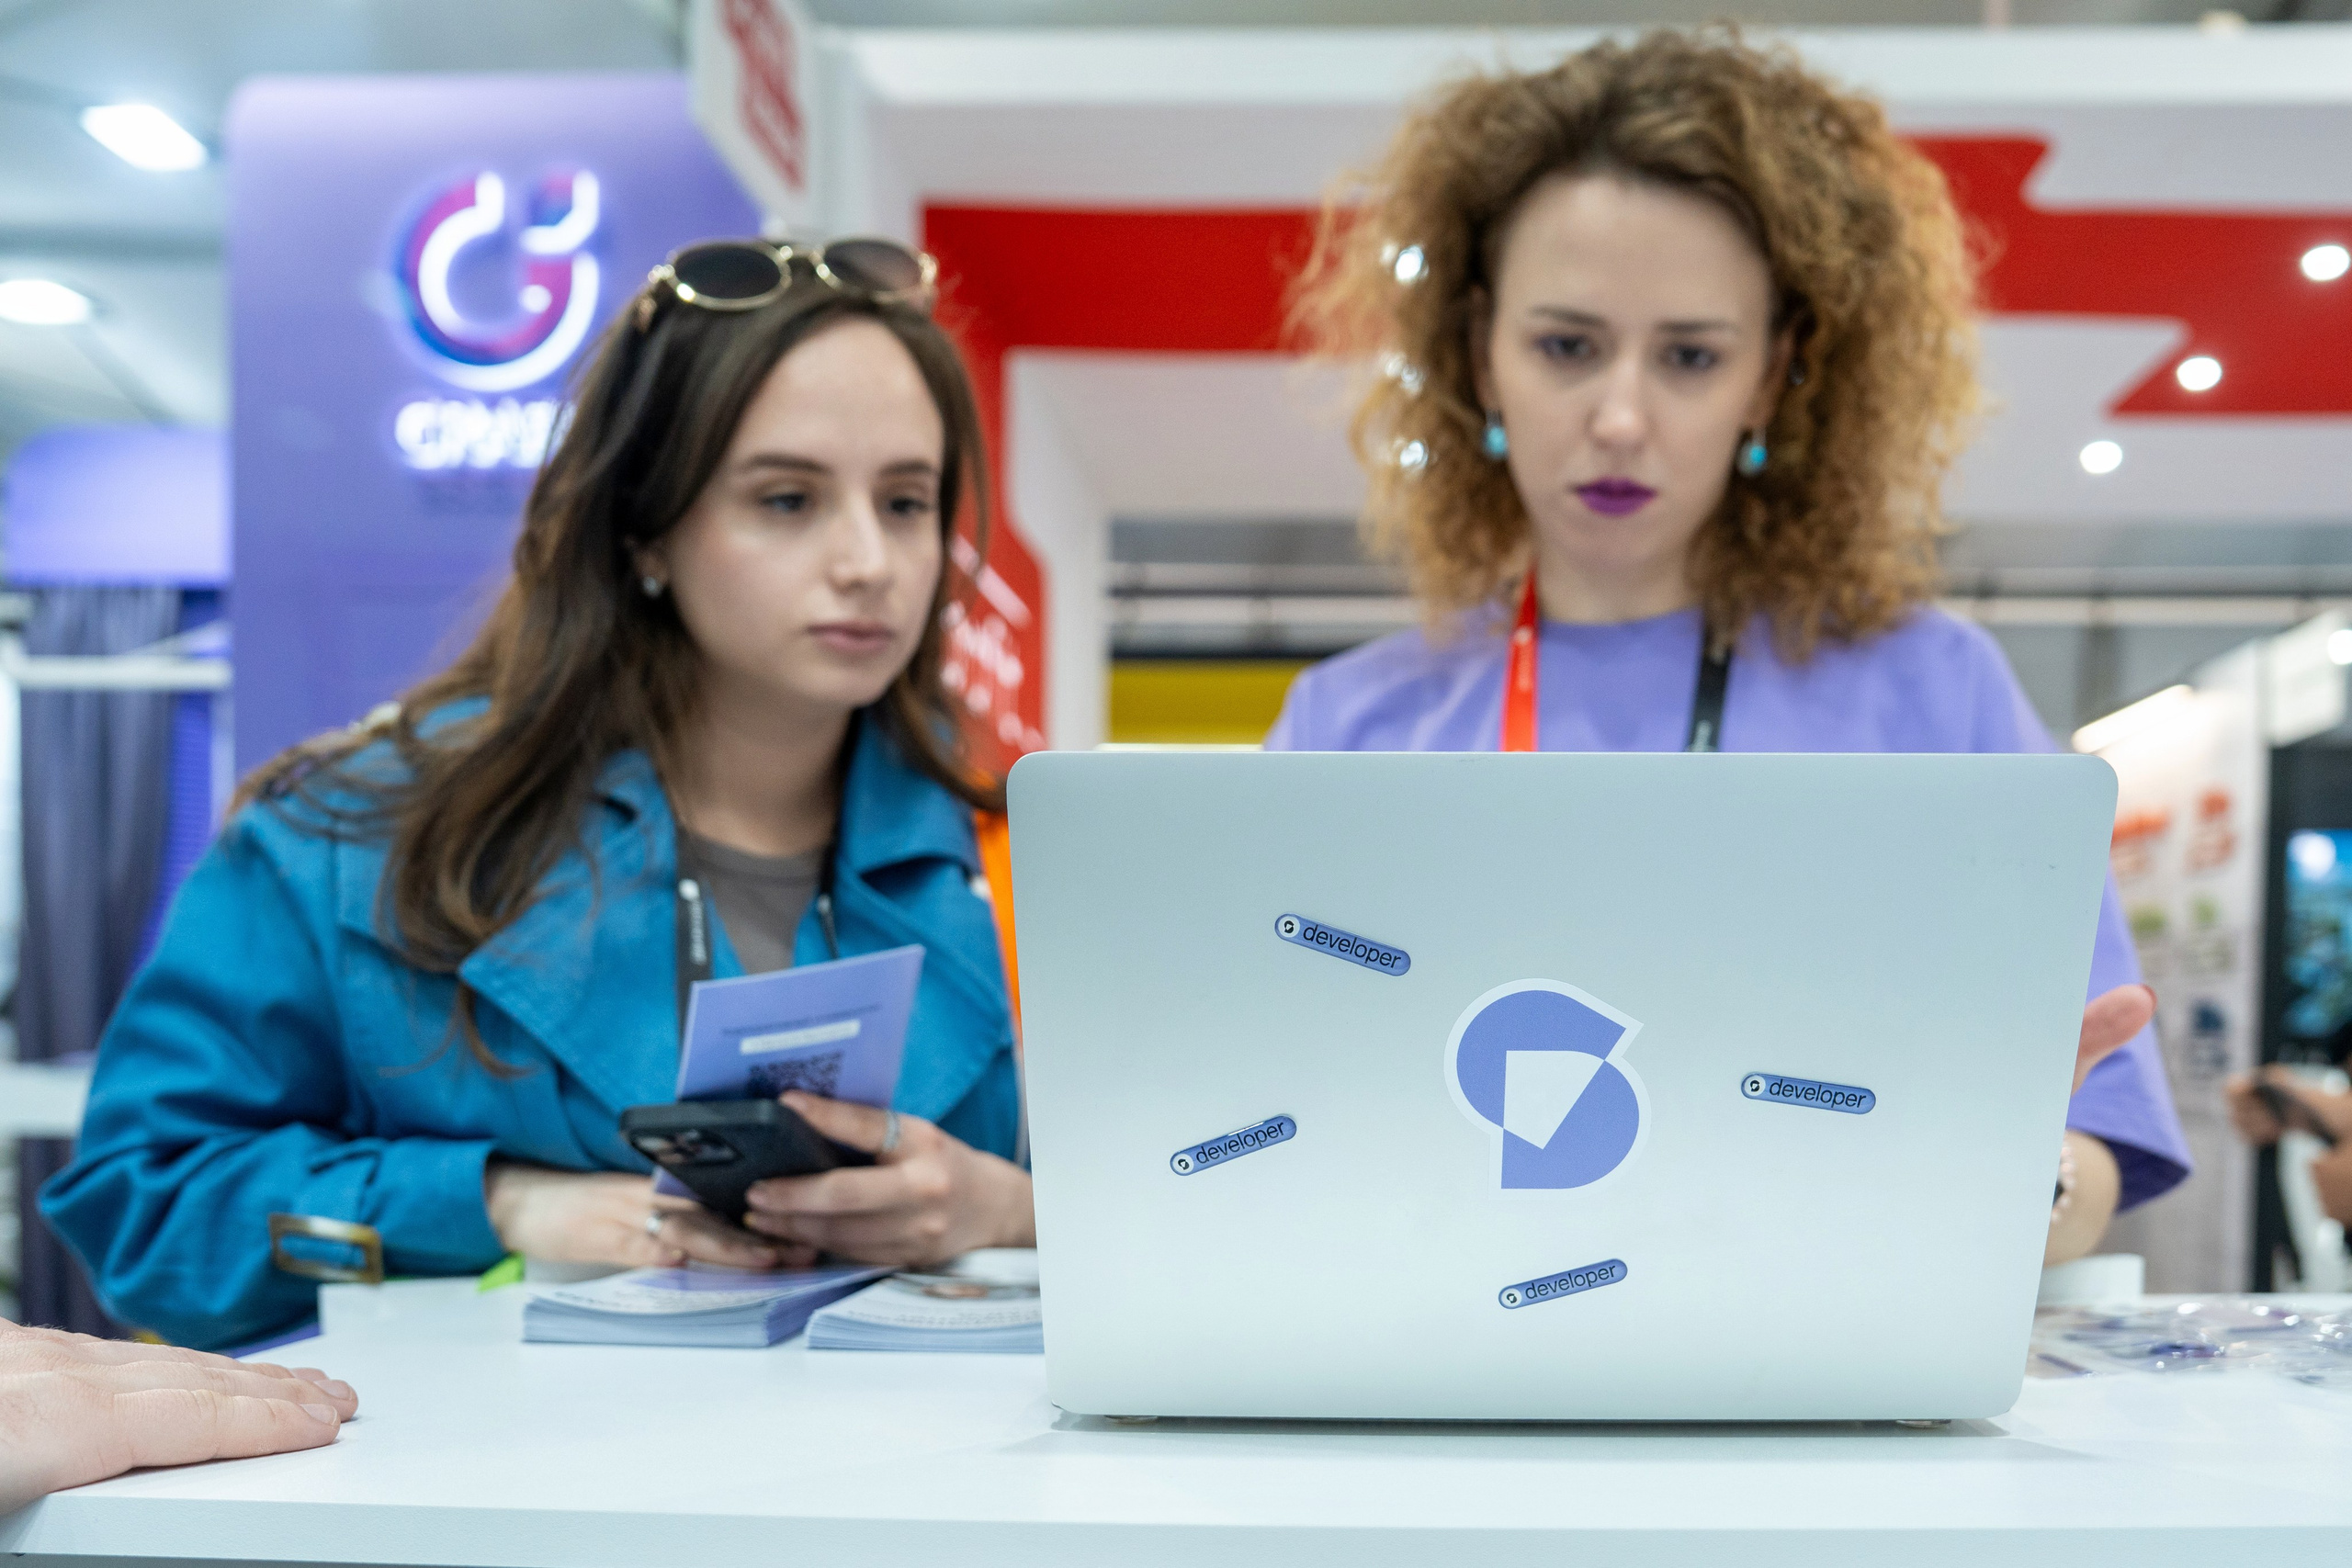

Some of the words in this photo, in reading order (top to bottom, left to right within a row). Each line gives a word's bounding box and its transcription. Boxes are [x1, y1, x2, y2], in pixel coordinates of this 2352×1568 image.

[1303, 924, 1401, 968] developer
[1769, 1078, 1867, 1108] developer
[1195, 1122, 1284, 1164] developer
[1525, 1265, 1616, 1300] developer
